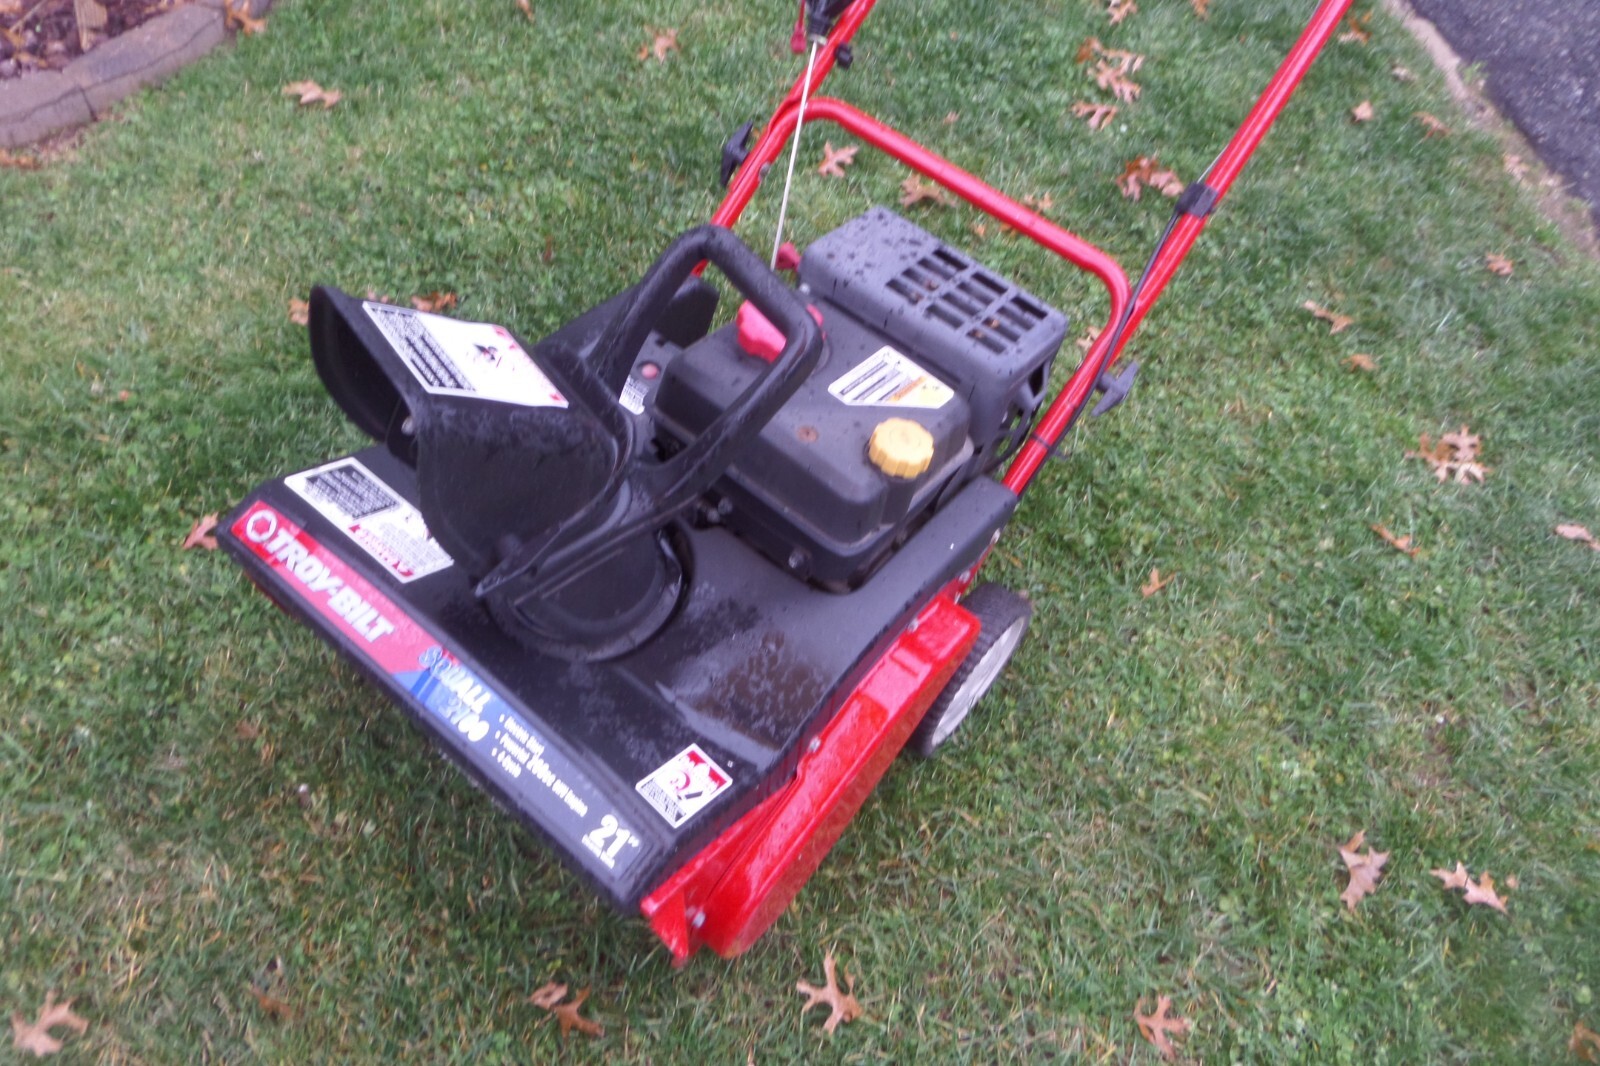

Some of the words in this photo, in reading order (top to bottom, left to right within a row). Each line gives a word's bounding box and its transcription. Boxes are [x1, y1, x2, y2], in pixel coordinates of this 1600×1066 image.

[264, 526, 395, 643] TROY-BILT
[419, 645, 491, 714] SQUALL
[438, 694, 490, 742] 2100
